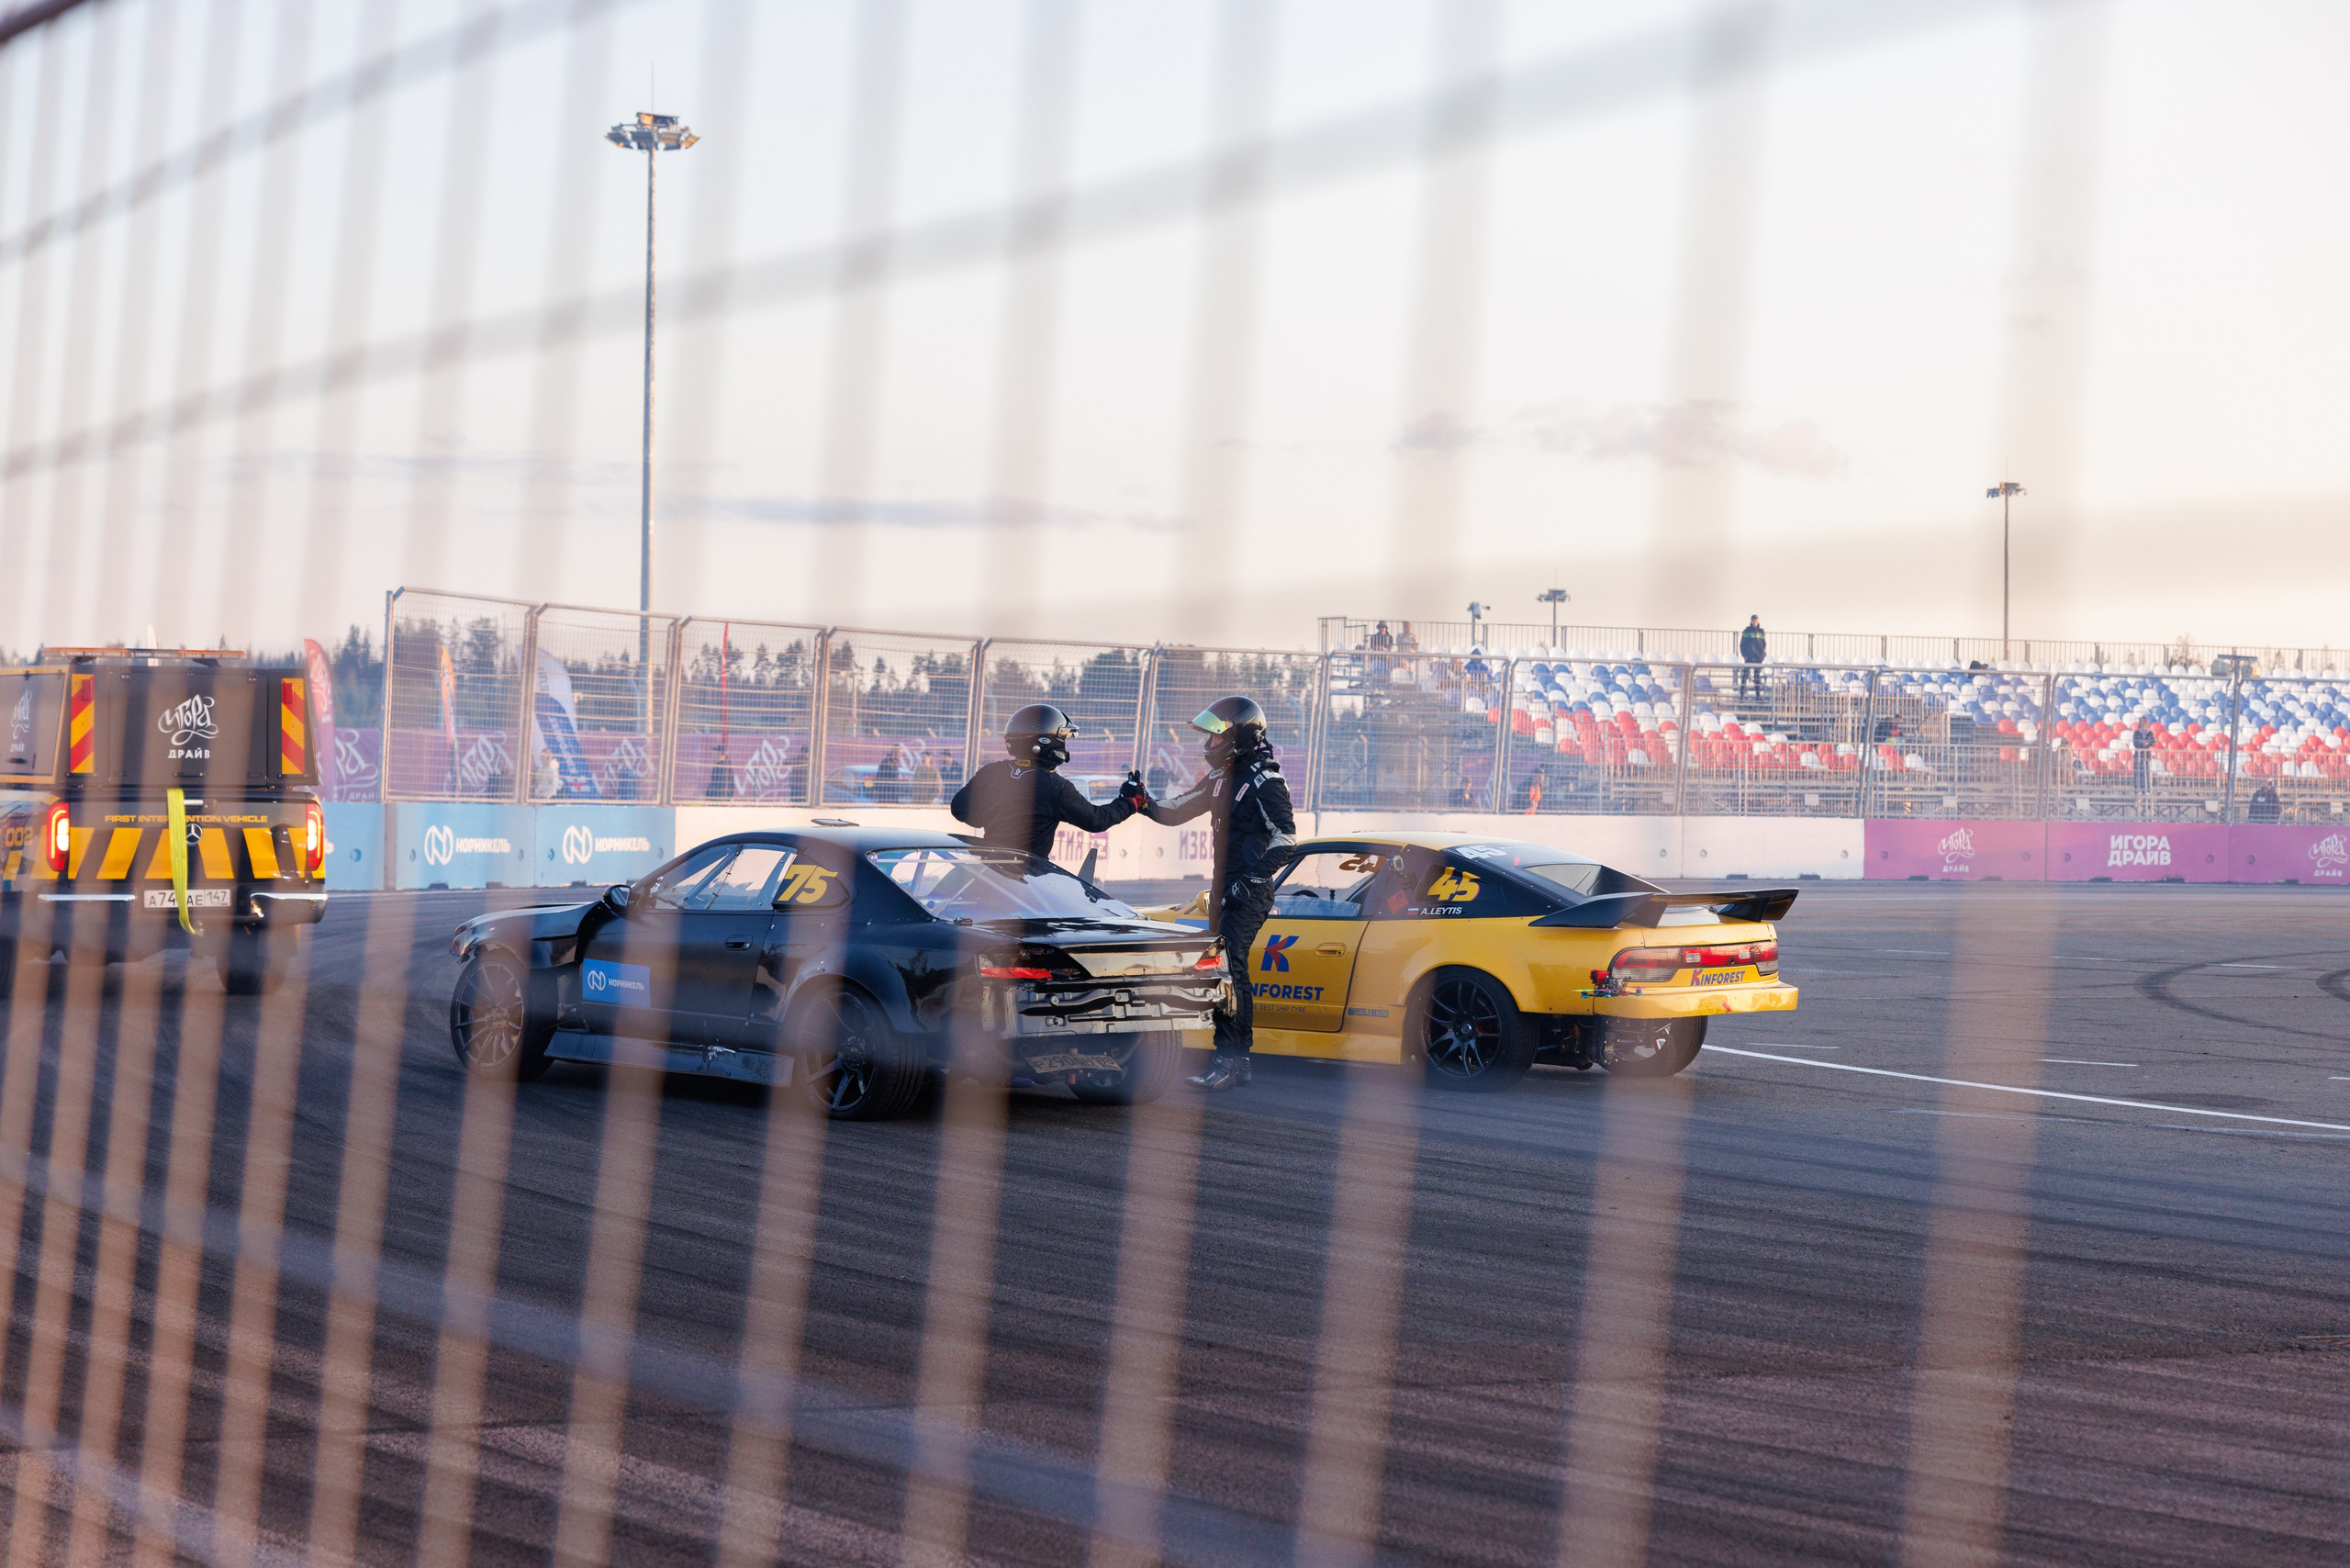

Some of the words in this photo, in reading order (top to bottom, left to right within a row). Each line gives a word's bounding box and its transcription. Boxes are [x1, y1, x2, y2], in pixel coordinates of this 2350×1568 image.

[167, 747, 210, 759] ДРАЙВ
[105, 814, 137, 823] FIRST
[223, 815, 268, 823] VEHICLE
[2110, 834, 2171, 851] ИГОРА
[777, 864, 839, 904] 75
[1427, 867, 1481, 902] 45
[1420, 906, 1462, 915] A.LEYTIS
[1690, 969, 1746, 986] KINFOREST
[1250, 982, 1325, 1001] NFOREST
